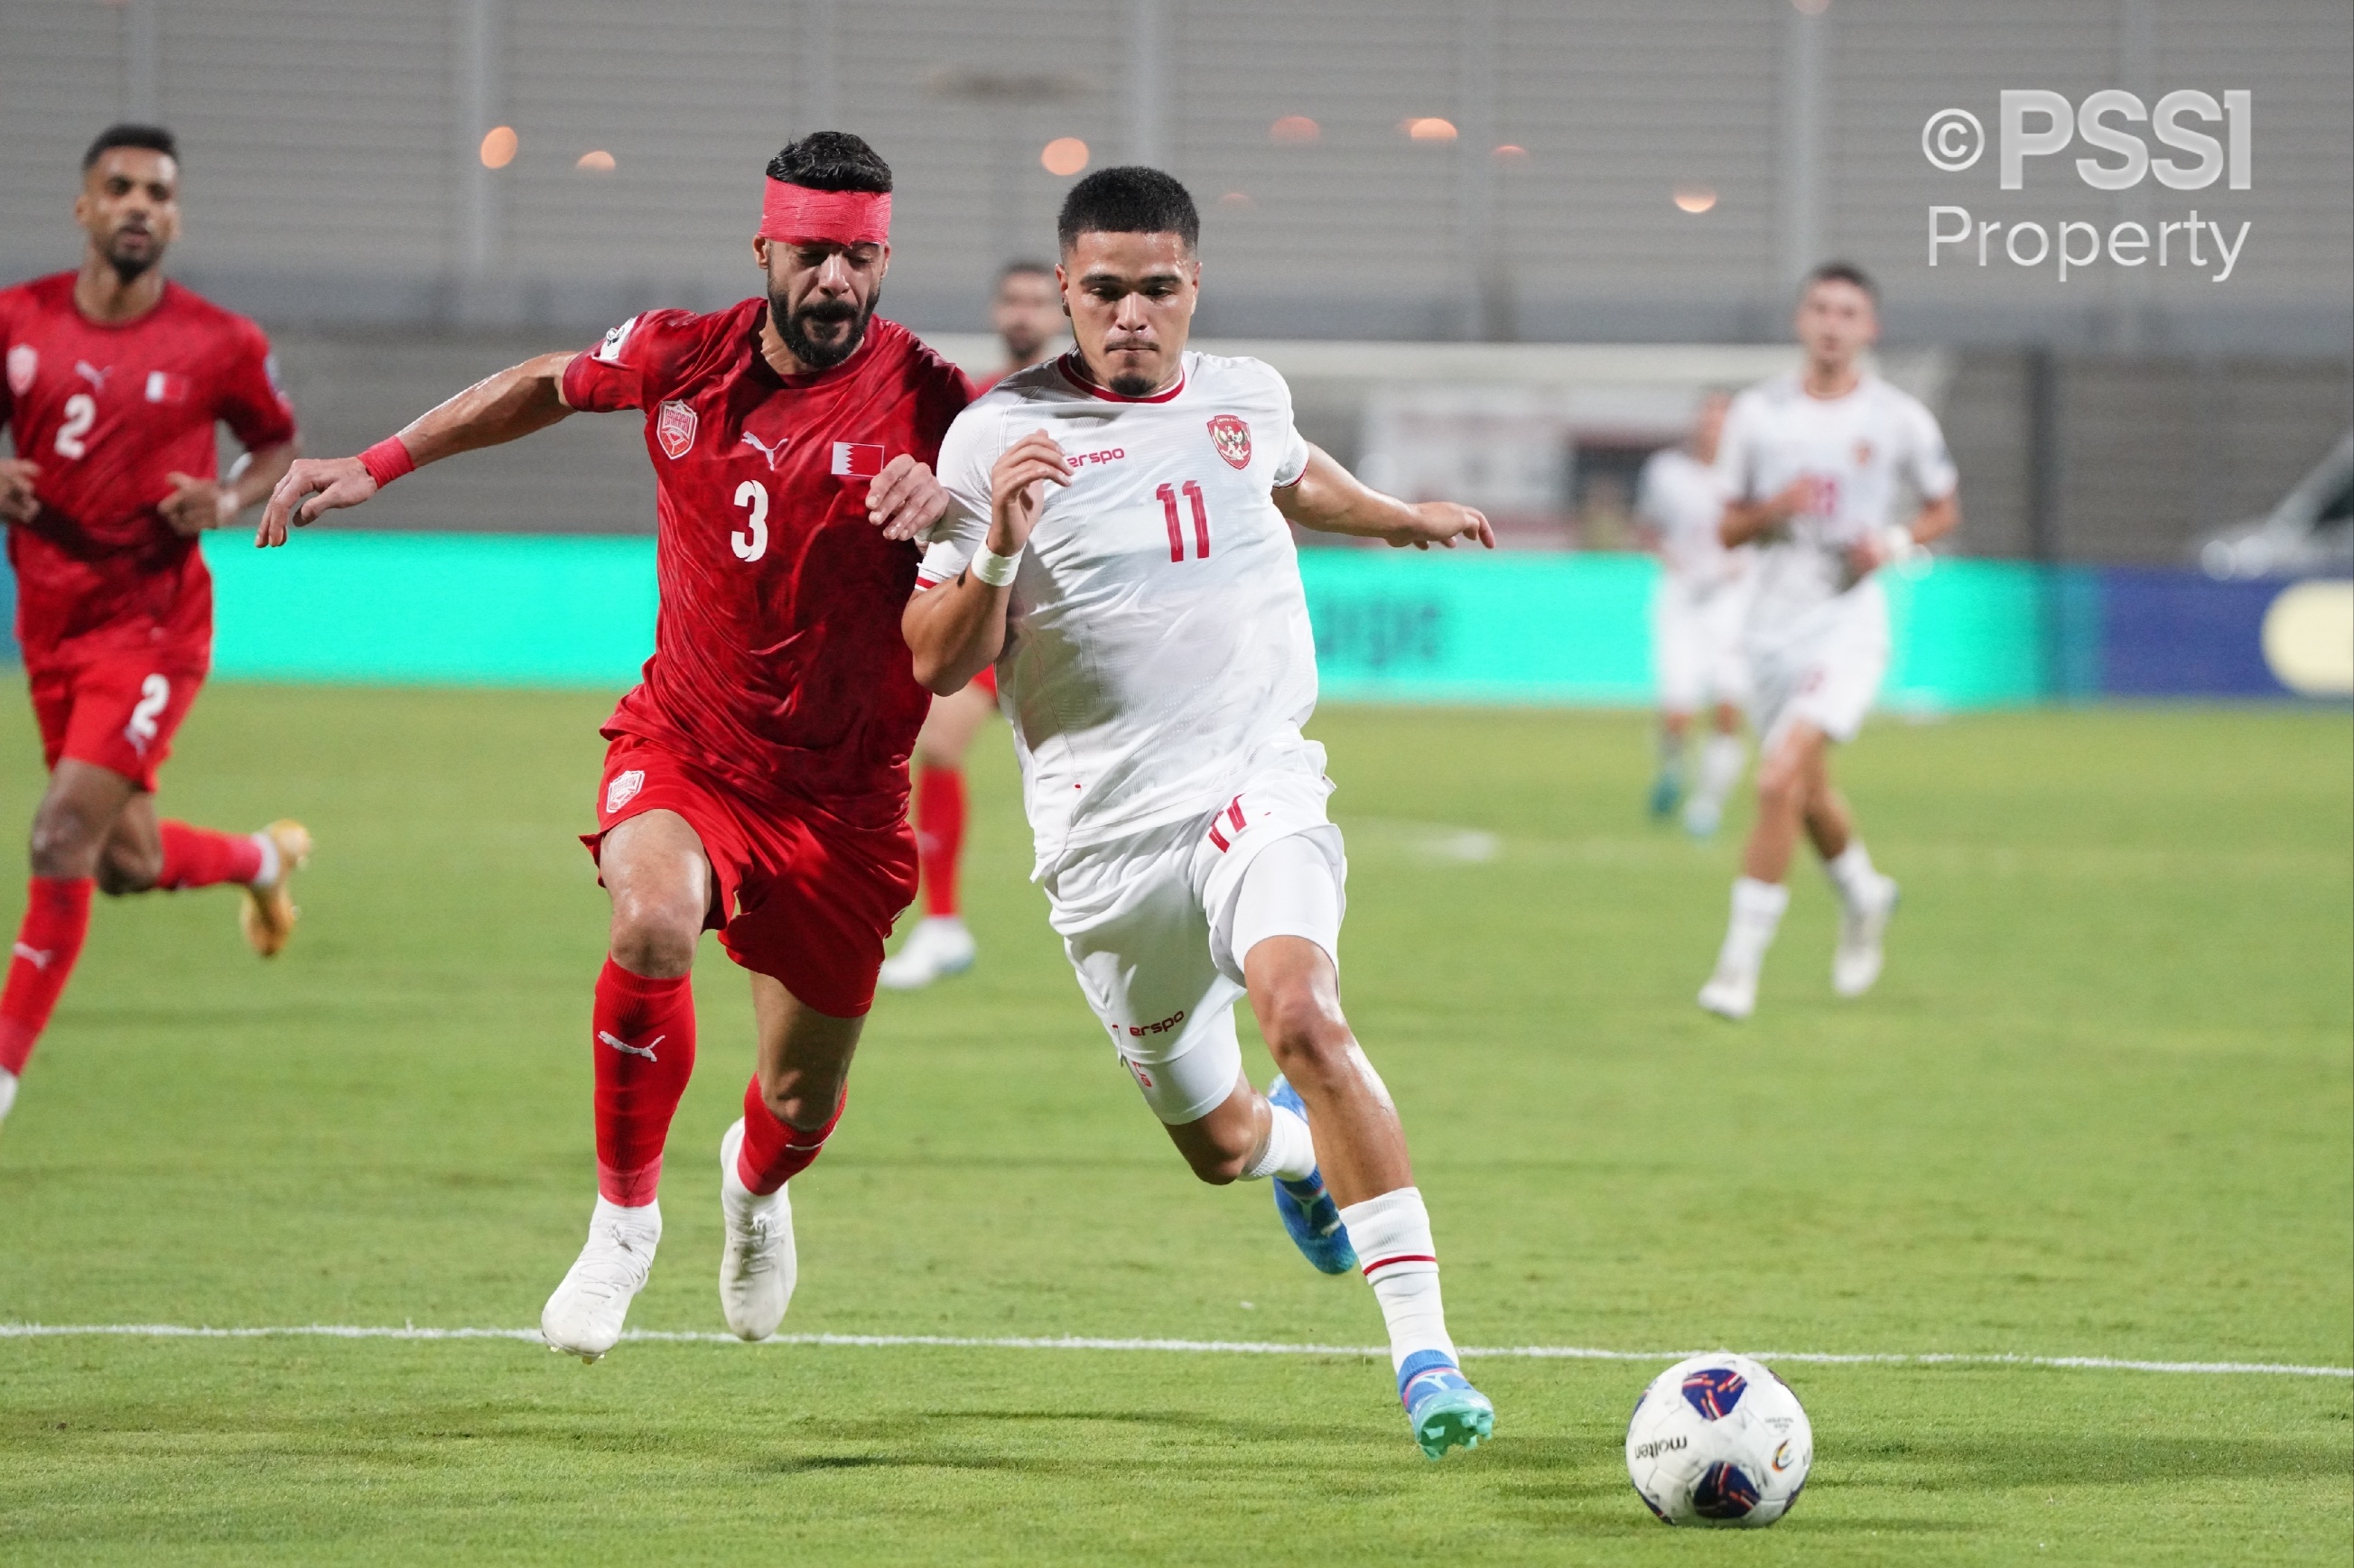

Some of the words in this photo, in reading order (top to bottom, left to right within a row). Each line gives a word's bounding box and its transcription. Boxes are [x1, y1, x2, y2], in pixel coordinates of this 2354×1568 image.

[55, 394, 97, 459] 2
[730, 479, 768, 562] 3
[1156, 480, 1210, 563] 11
[129, 673, 170, 739] 2
[1129, 1010, 1185, 1036] erspo
[1634, 1435, 1688, 1460] molten
